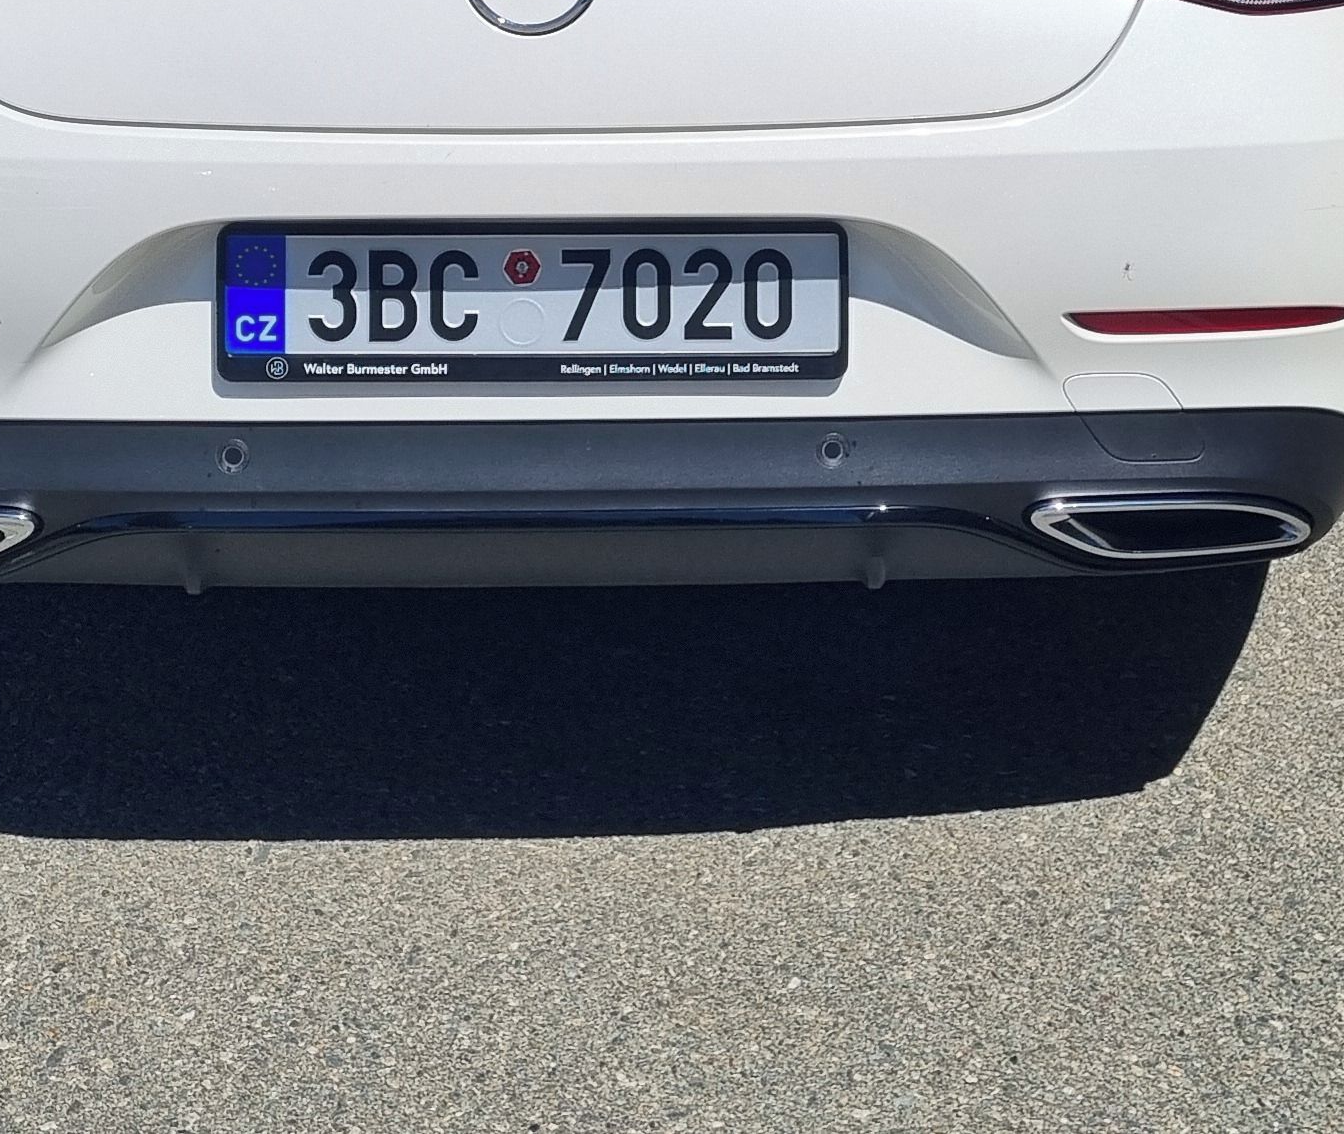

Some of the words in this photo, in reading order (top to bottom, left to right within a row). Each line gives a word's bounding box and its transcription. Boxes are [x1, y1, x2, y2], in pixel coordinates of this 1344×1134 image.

[308, 250, 479, 342] 3BC
[561, 248, 793, 342] 7020
[235, 315, 277, 342] CZ
[303, 363, 343, 375] Walter
[346, 363, 408, 375] Burmester
[410, 363, 449, 375] GmbH
[560, 364, 601, 377] Rellingen
[609, 364, 651, 374] Elmshorn
[657, 364, 687, 374] Wedel
[694, 364, 725, 374] Ellerau
[732, 363, 750, 373] Bad
[752, 362, 799, 373] Bramstedt
